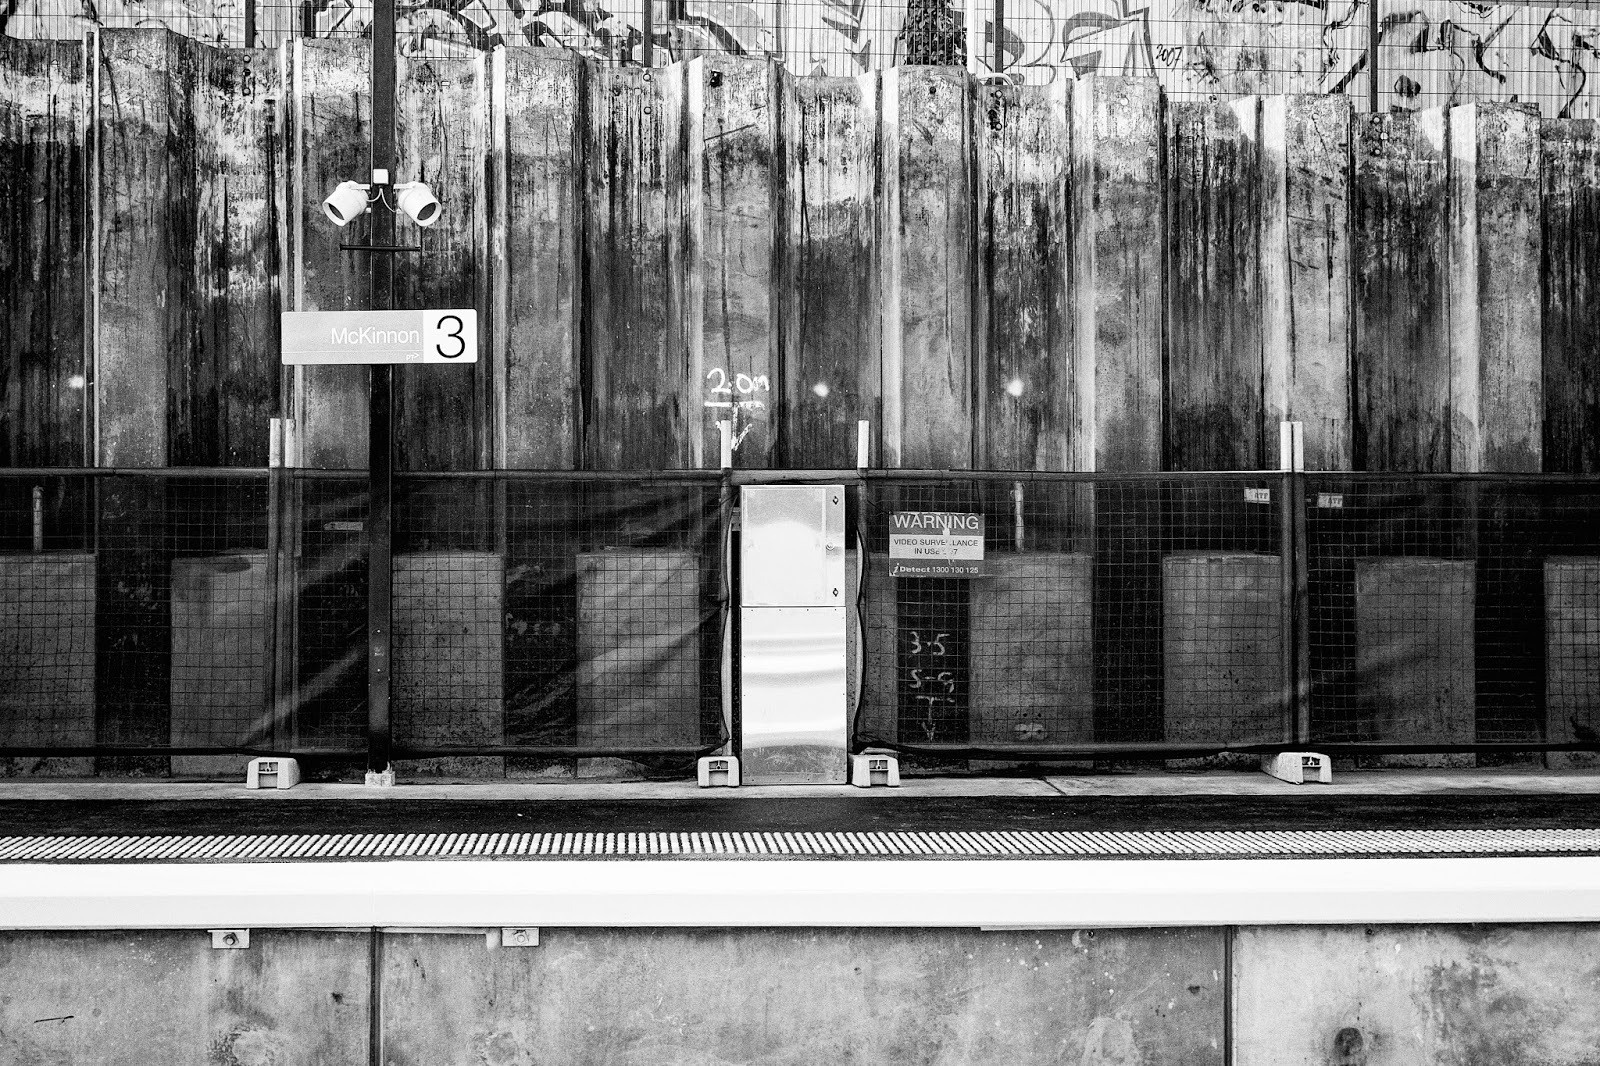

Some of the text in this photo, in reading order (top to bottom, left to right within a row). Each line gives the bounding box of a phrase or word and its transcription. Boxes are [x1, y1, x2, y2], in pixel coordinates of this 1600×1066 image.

[1156, 43, 1184, 72] 2007
[331, 315, 466, 359] McKinnon 3
[893, 514, 979, 530] WARNING
[893, 538, 979, 547] VIDEO SURVELANCE
[932, 566, 950, 574] 1300
[951, 566, 964, 574] 130
